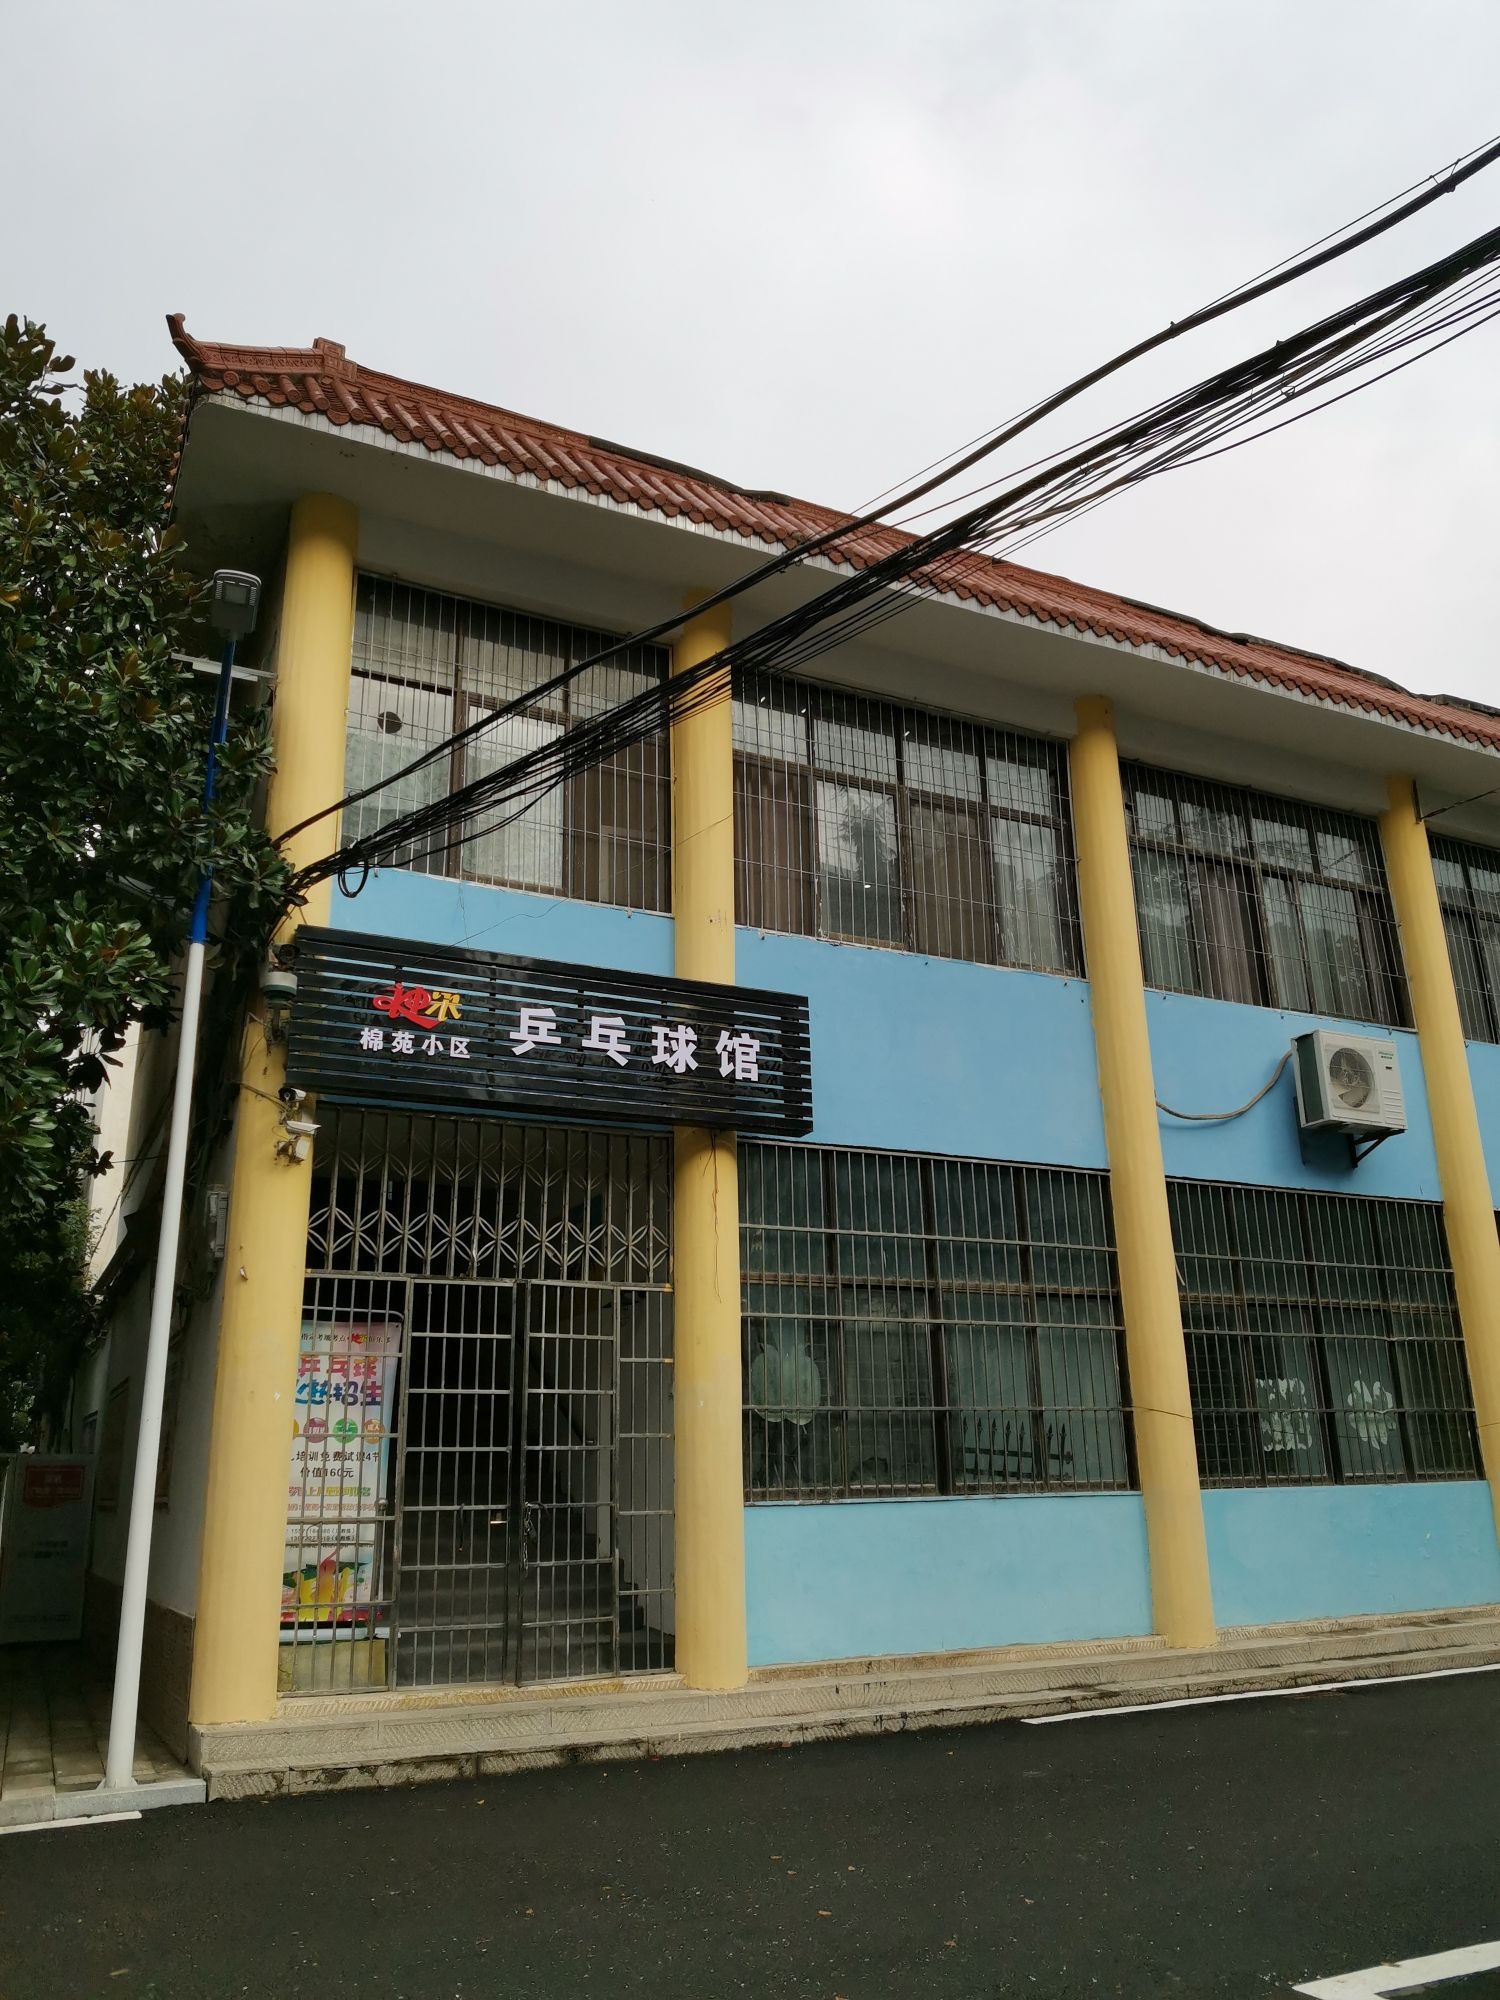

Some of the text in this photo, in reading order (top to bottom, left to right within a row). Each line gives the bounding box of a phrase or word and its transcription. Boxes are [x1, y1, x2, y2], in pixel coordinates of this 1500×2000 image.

[360, 1027, 470, 1058] 棉苑小区
[509, 1007, 760, 1082] 乒乓球馆
[291, 1450, 380, 1463] 培训免费试课4节
